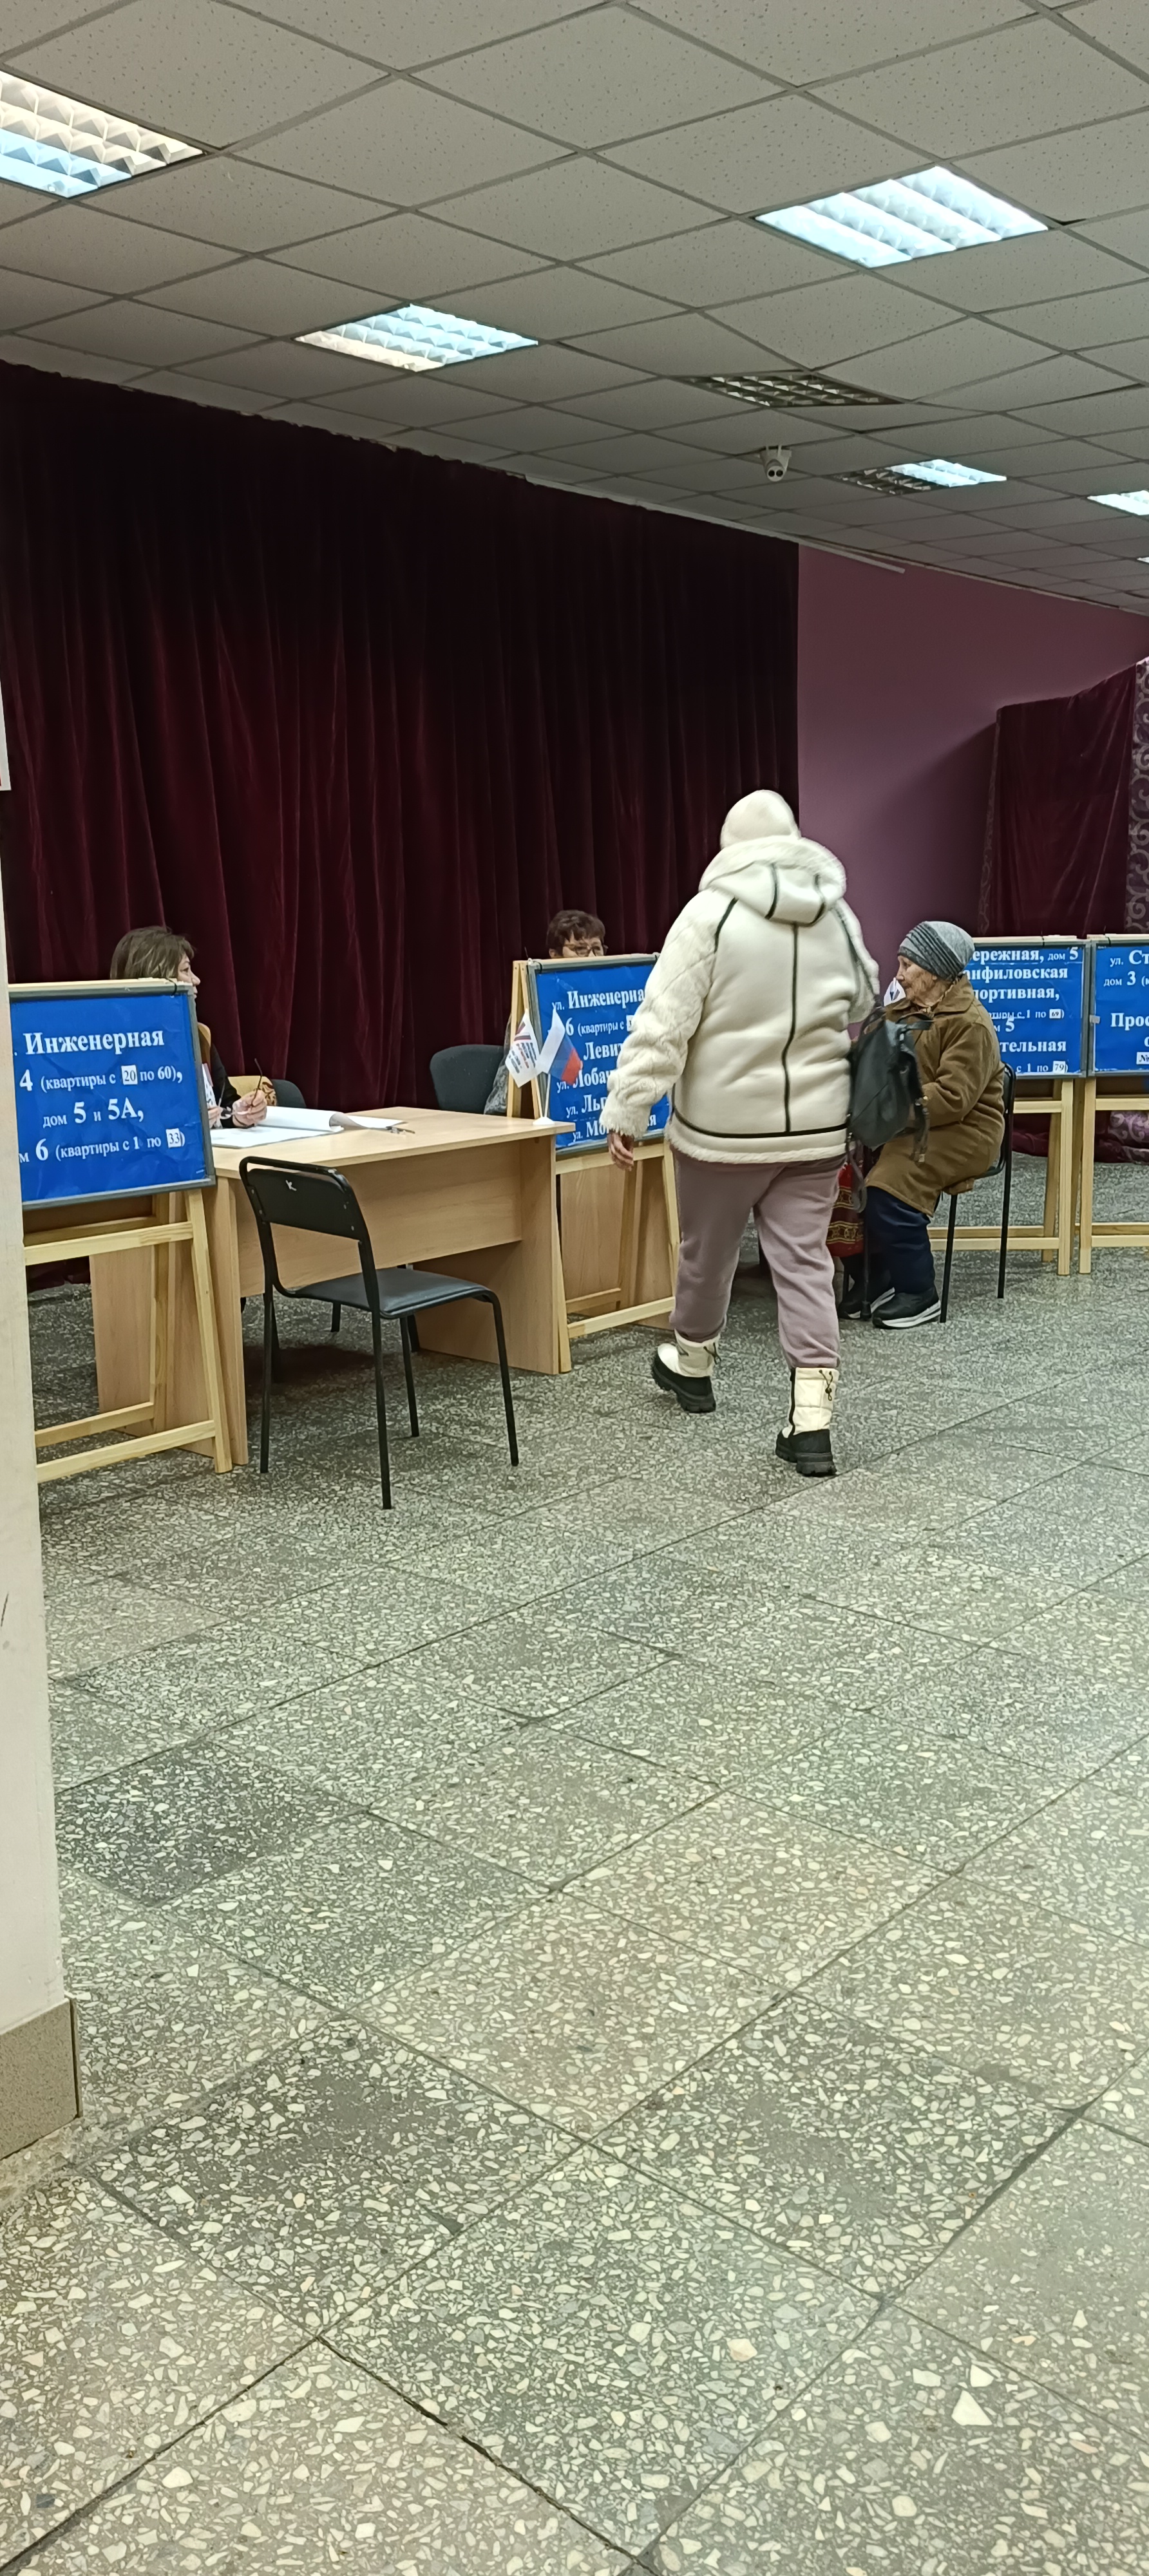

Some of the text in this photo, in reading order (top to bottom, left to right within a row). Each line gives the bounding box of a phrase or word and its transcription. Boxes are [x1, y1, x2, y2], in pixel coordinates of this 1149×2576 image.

[973, 947, 1078, 965] ережная, дом 5
[1110, 950, 1149, 967] ул. Ст
[963, 967, 1068, 983] анфиловская
[1103, 978, 1122, 987] дом
[1127, 971, 1136, 985] 3
[567, 989, 645, 1009] Инженерна
[974, 987, 1059, 1003] портивная,
[1027, 1010, 1030, 1018] 1
[565, 1017, 574, 1036] 6
[578, 1021, 618, 1036] (квартиры
[620, 1021, 624, 1030] с
[1005, 1016, 1014, 1032] 5
[23, 1030, 164, 1055] Инженерная
[1000, 1041, 1067, 1052] тельная
[1027, 1063, 1030, 1072] 1
[1054, 1063, 1068, 1074] 79)
[19, 1066, 183, 1094] 4 (квартиры с 20 по 60),
[556, 1081, 569, 1093] ул.
[43, 1097, 144, 1128] дом 5 и 5А,
[566, 1106, 578, 1119] ул.
[573, 1130, 584, 1142] ул.
[35, 1138, 48, 1160] 6
[55, 1142, 119, 1162] (квартиры
[122, 1140, 129, 1151] с
[133, 1136, 140, 1150] 1
[147, 1137, 161, 1148] по
